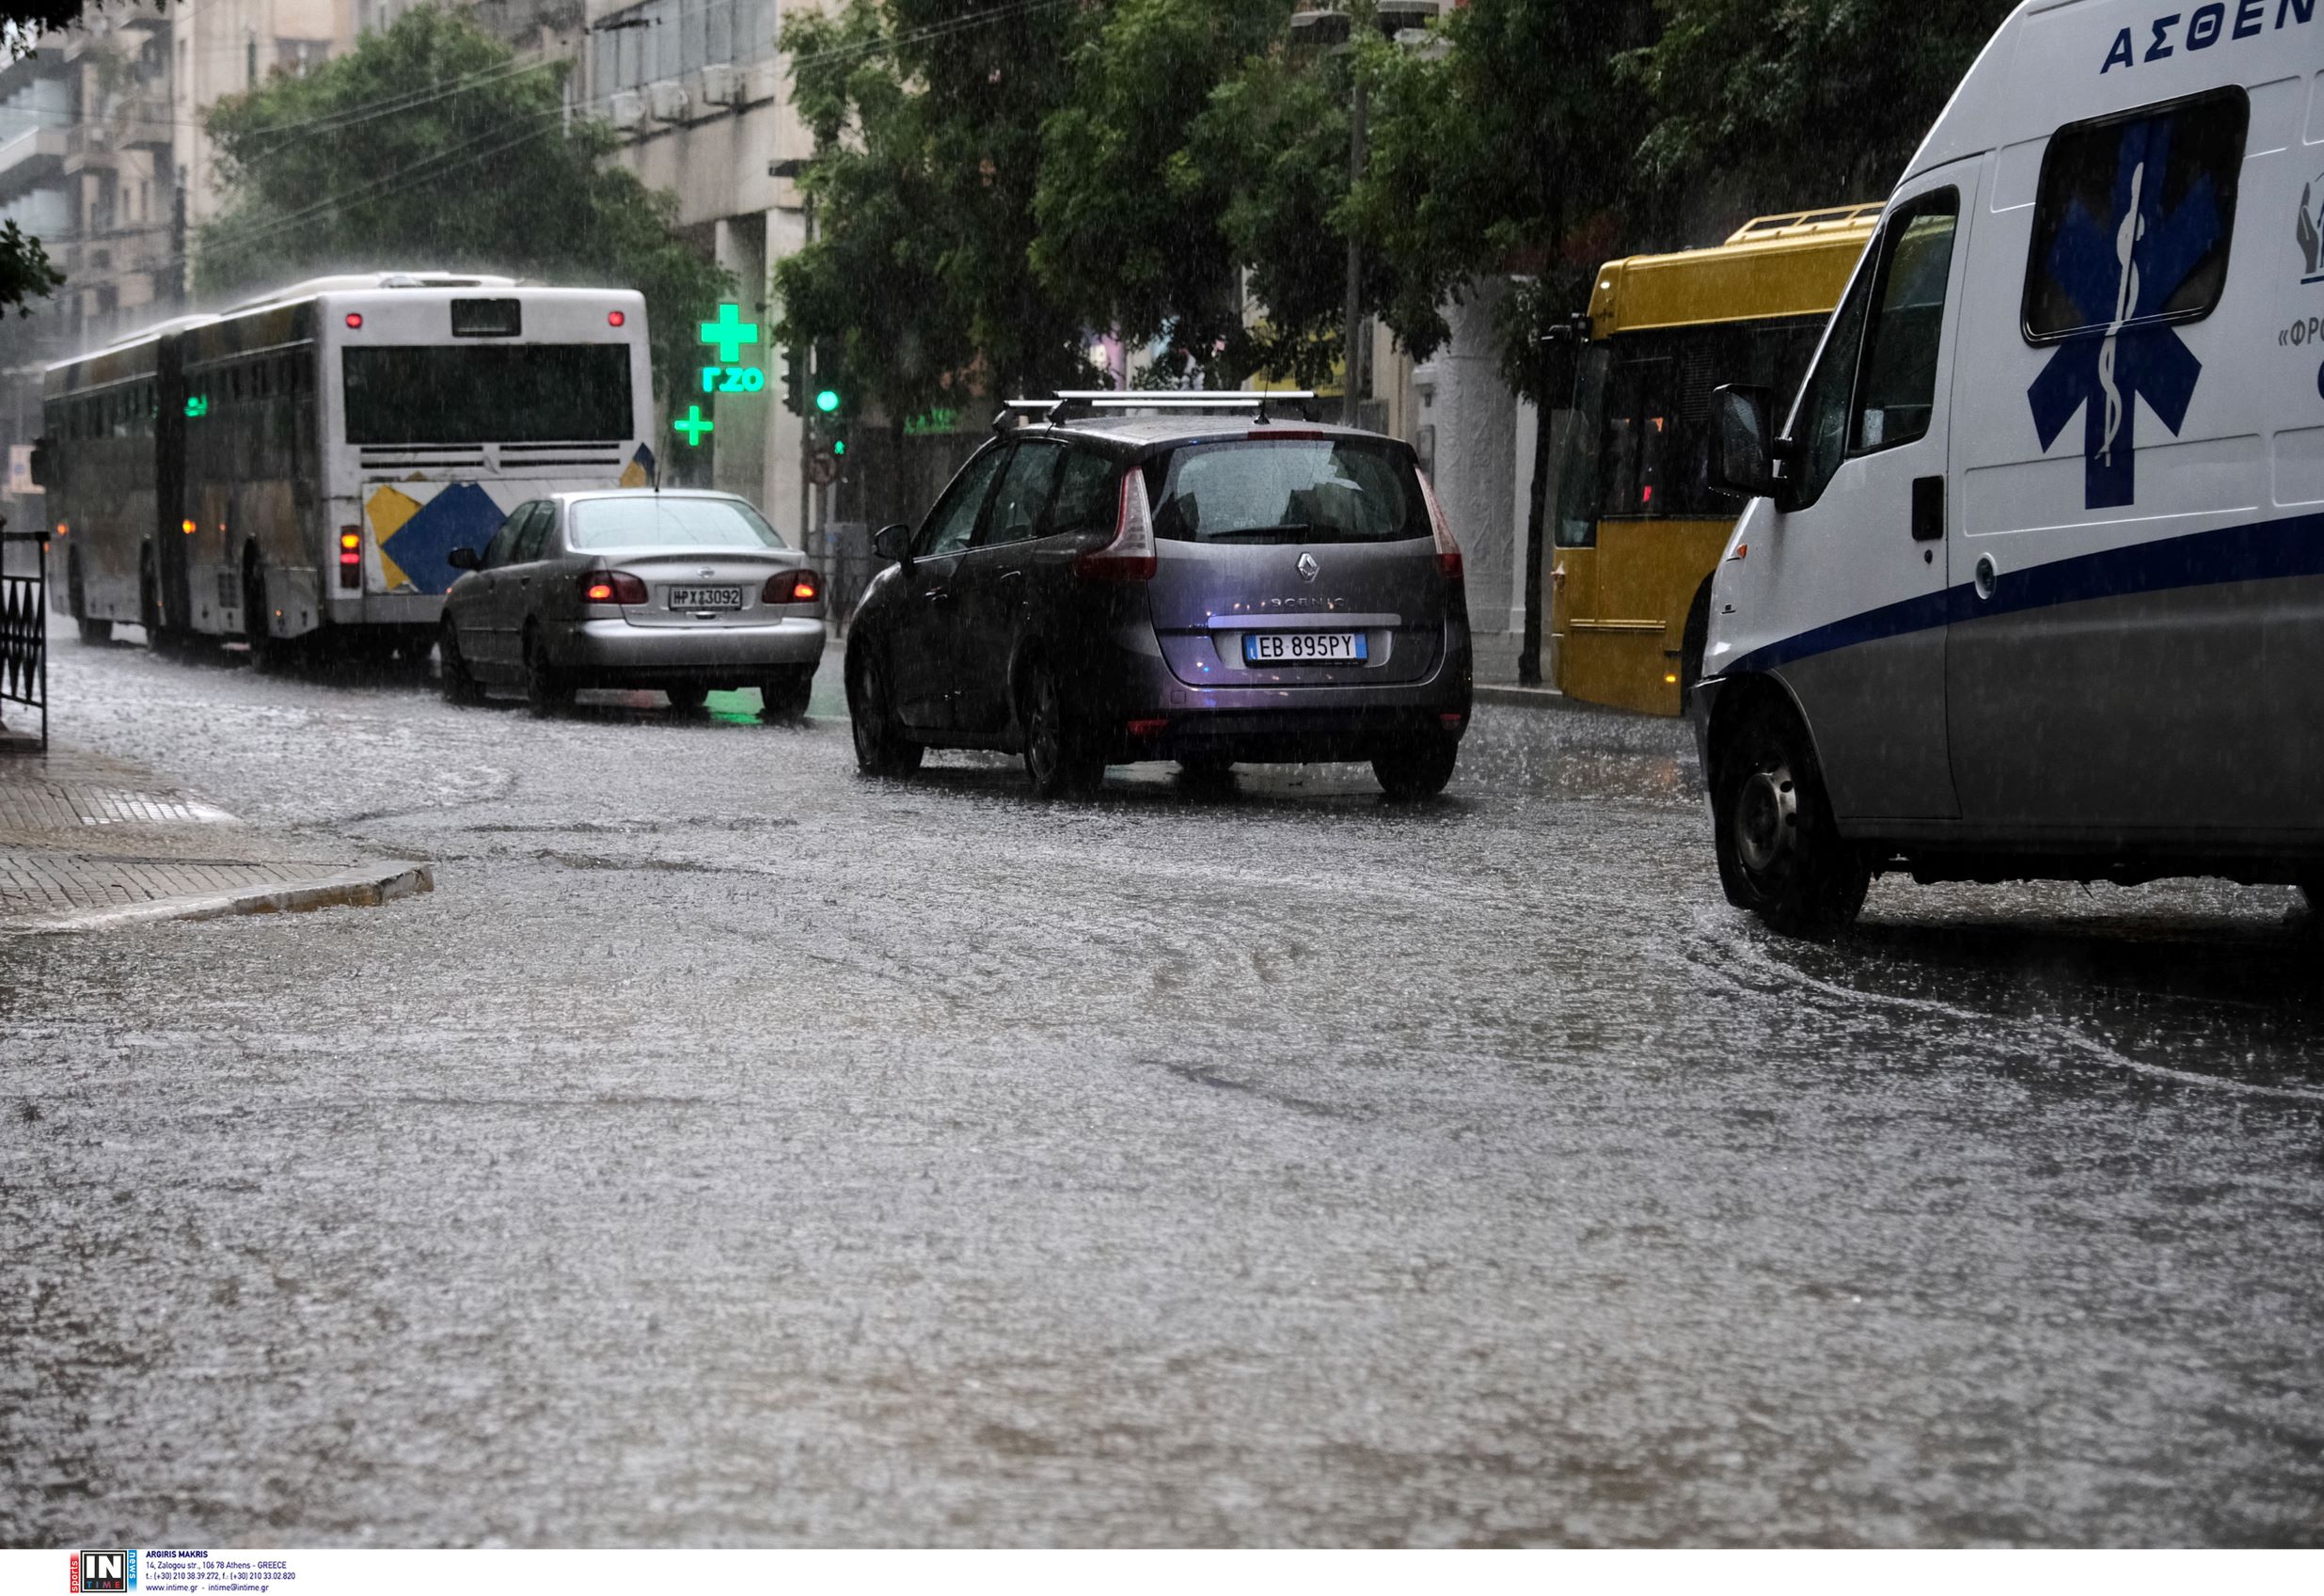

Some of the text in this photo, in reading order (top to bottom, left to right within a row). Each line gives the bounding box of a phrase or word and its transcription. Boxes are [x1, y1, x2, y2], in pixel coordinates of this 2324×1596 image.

[706, 590, 739, 605] 3092
[1259, 635, 1352, 657] EB 895PY
